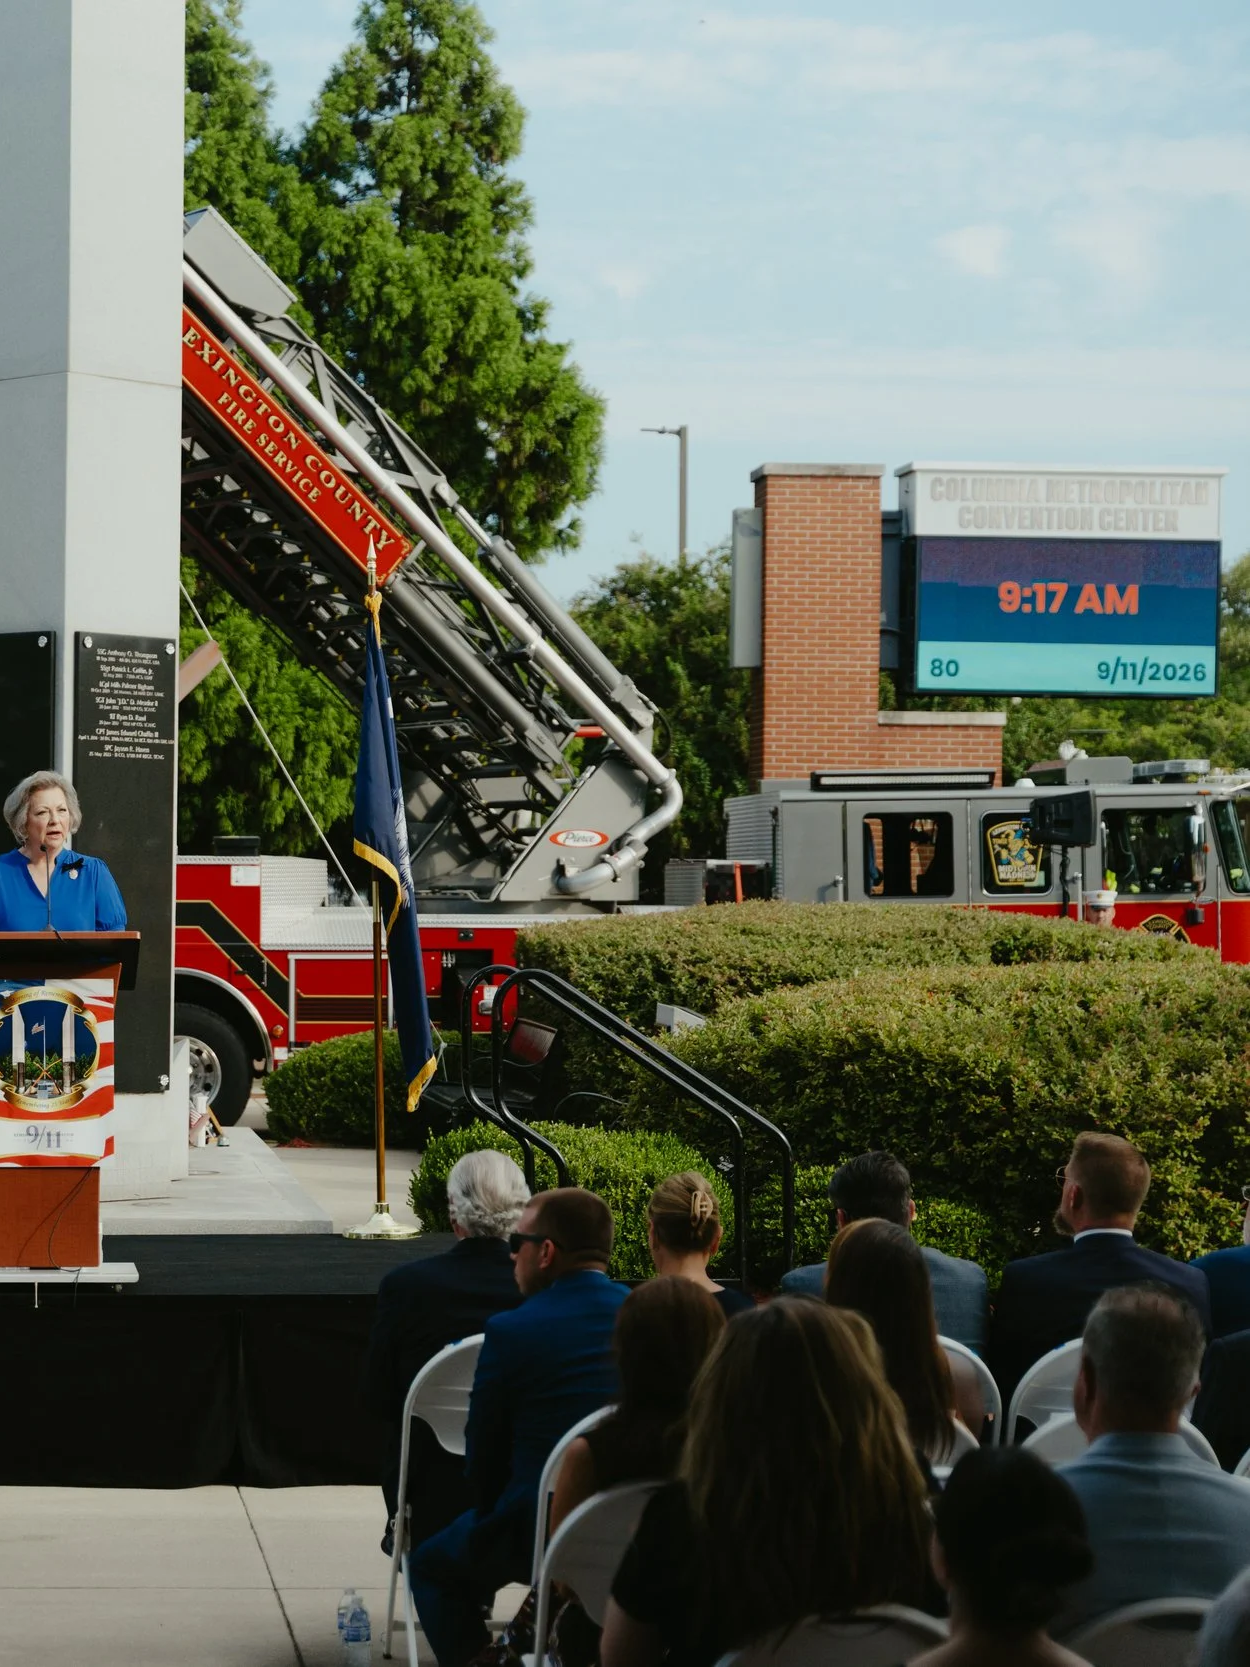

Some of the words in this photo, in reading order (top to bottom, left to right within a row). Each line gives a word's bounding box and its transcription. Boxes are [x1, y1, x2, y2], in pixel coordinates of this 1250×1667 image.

[182, 326, 302, 451] EXINGTON
[305, 454, 395, 551] COUNTY
[217, 392, 257, 435] FIRE
[256, 433, 322, 503] SERVICE
[930, 476, 1040, 503] COLUMBIA
[1045, 478, 1209, 506] METROPOLITAN
[958, 505, 1093, 531] CONVENTION
[1099, 506, 1179, 533] CENTER
[997, 581, 1068, 614] 9:17
[1073, 583, 1140, 615] AM
[930, 658, 960, 678] 80
[1097, 656, 1207, 685] 9/11/2026
[562, 831, 596, 844] Pierce
[26, 1124, 61, 1151] 9/11
